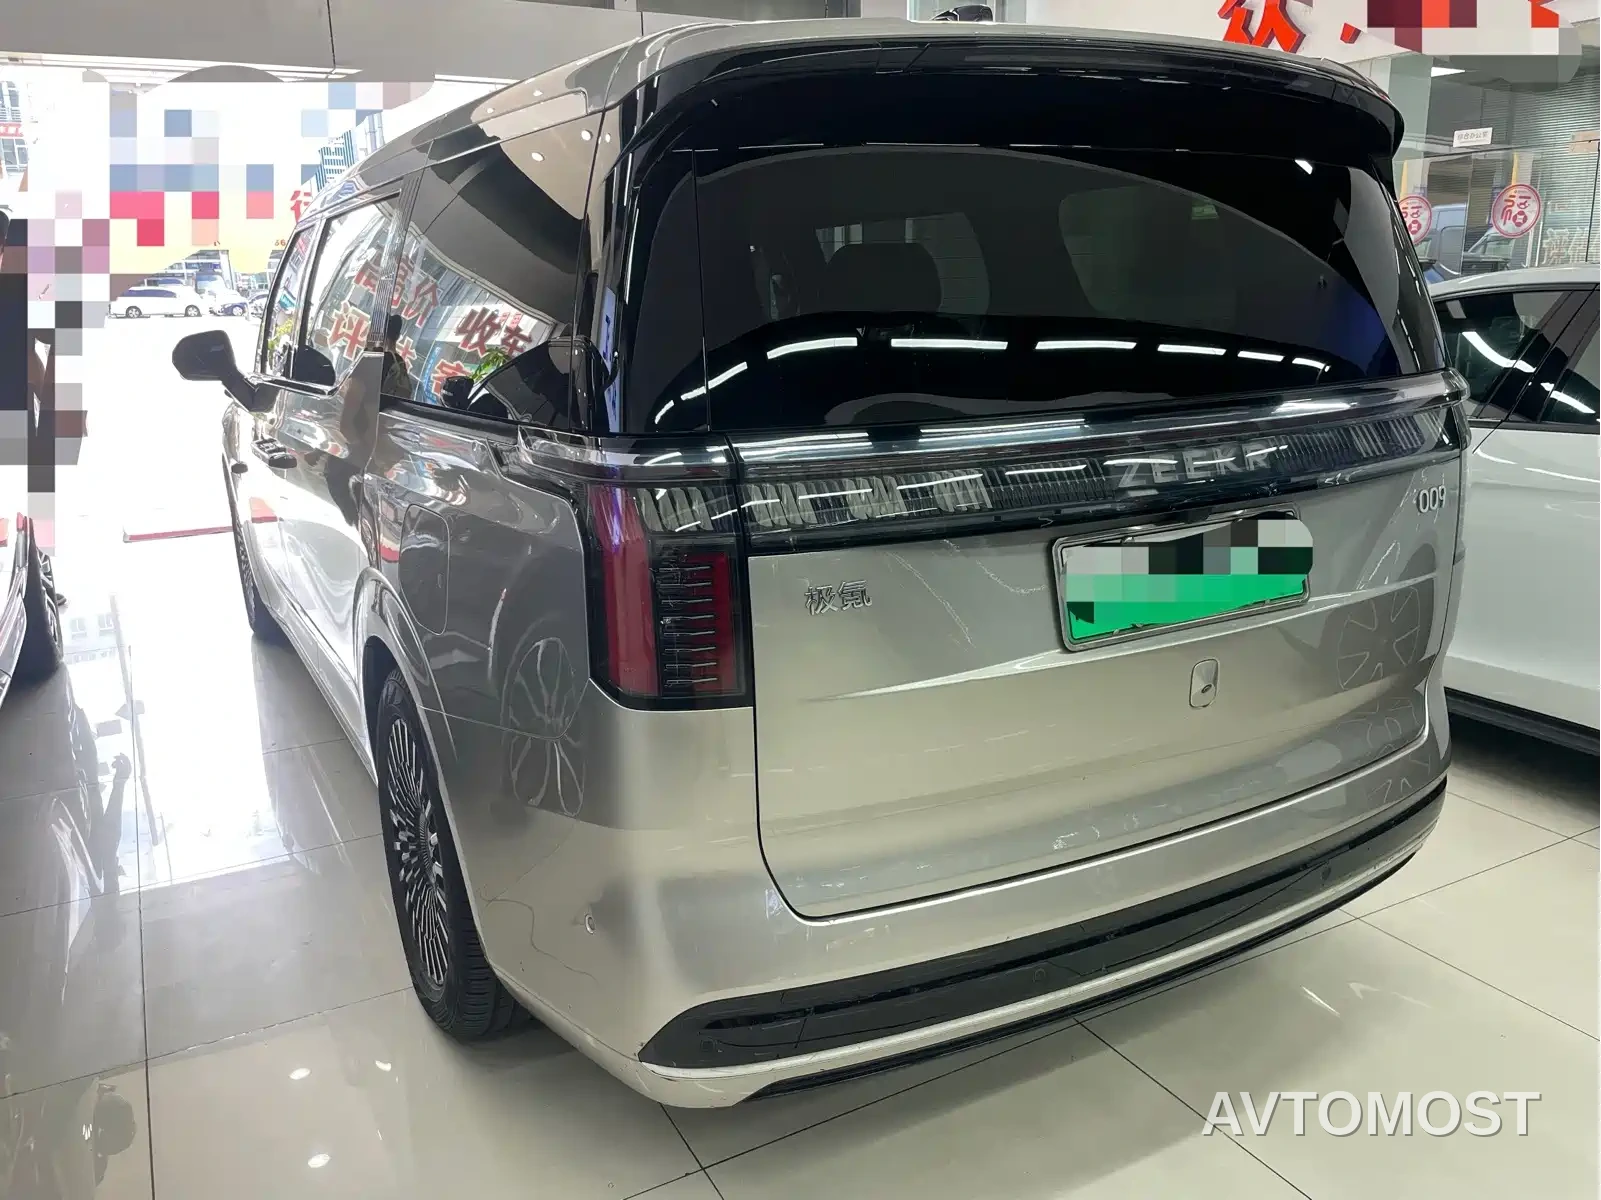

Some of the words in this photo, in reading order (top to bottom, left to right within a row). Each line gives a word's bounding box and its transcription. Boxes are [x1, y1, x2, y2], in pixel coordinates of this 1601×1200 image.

[1110, 441, 1272, 489] ZEEKR
[1417, 485, 1447, 513] 009
[804, 579, 873, 616] 极氪
